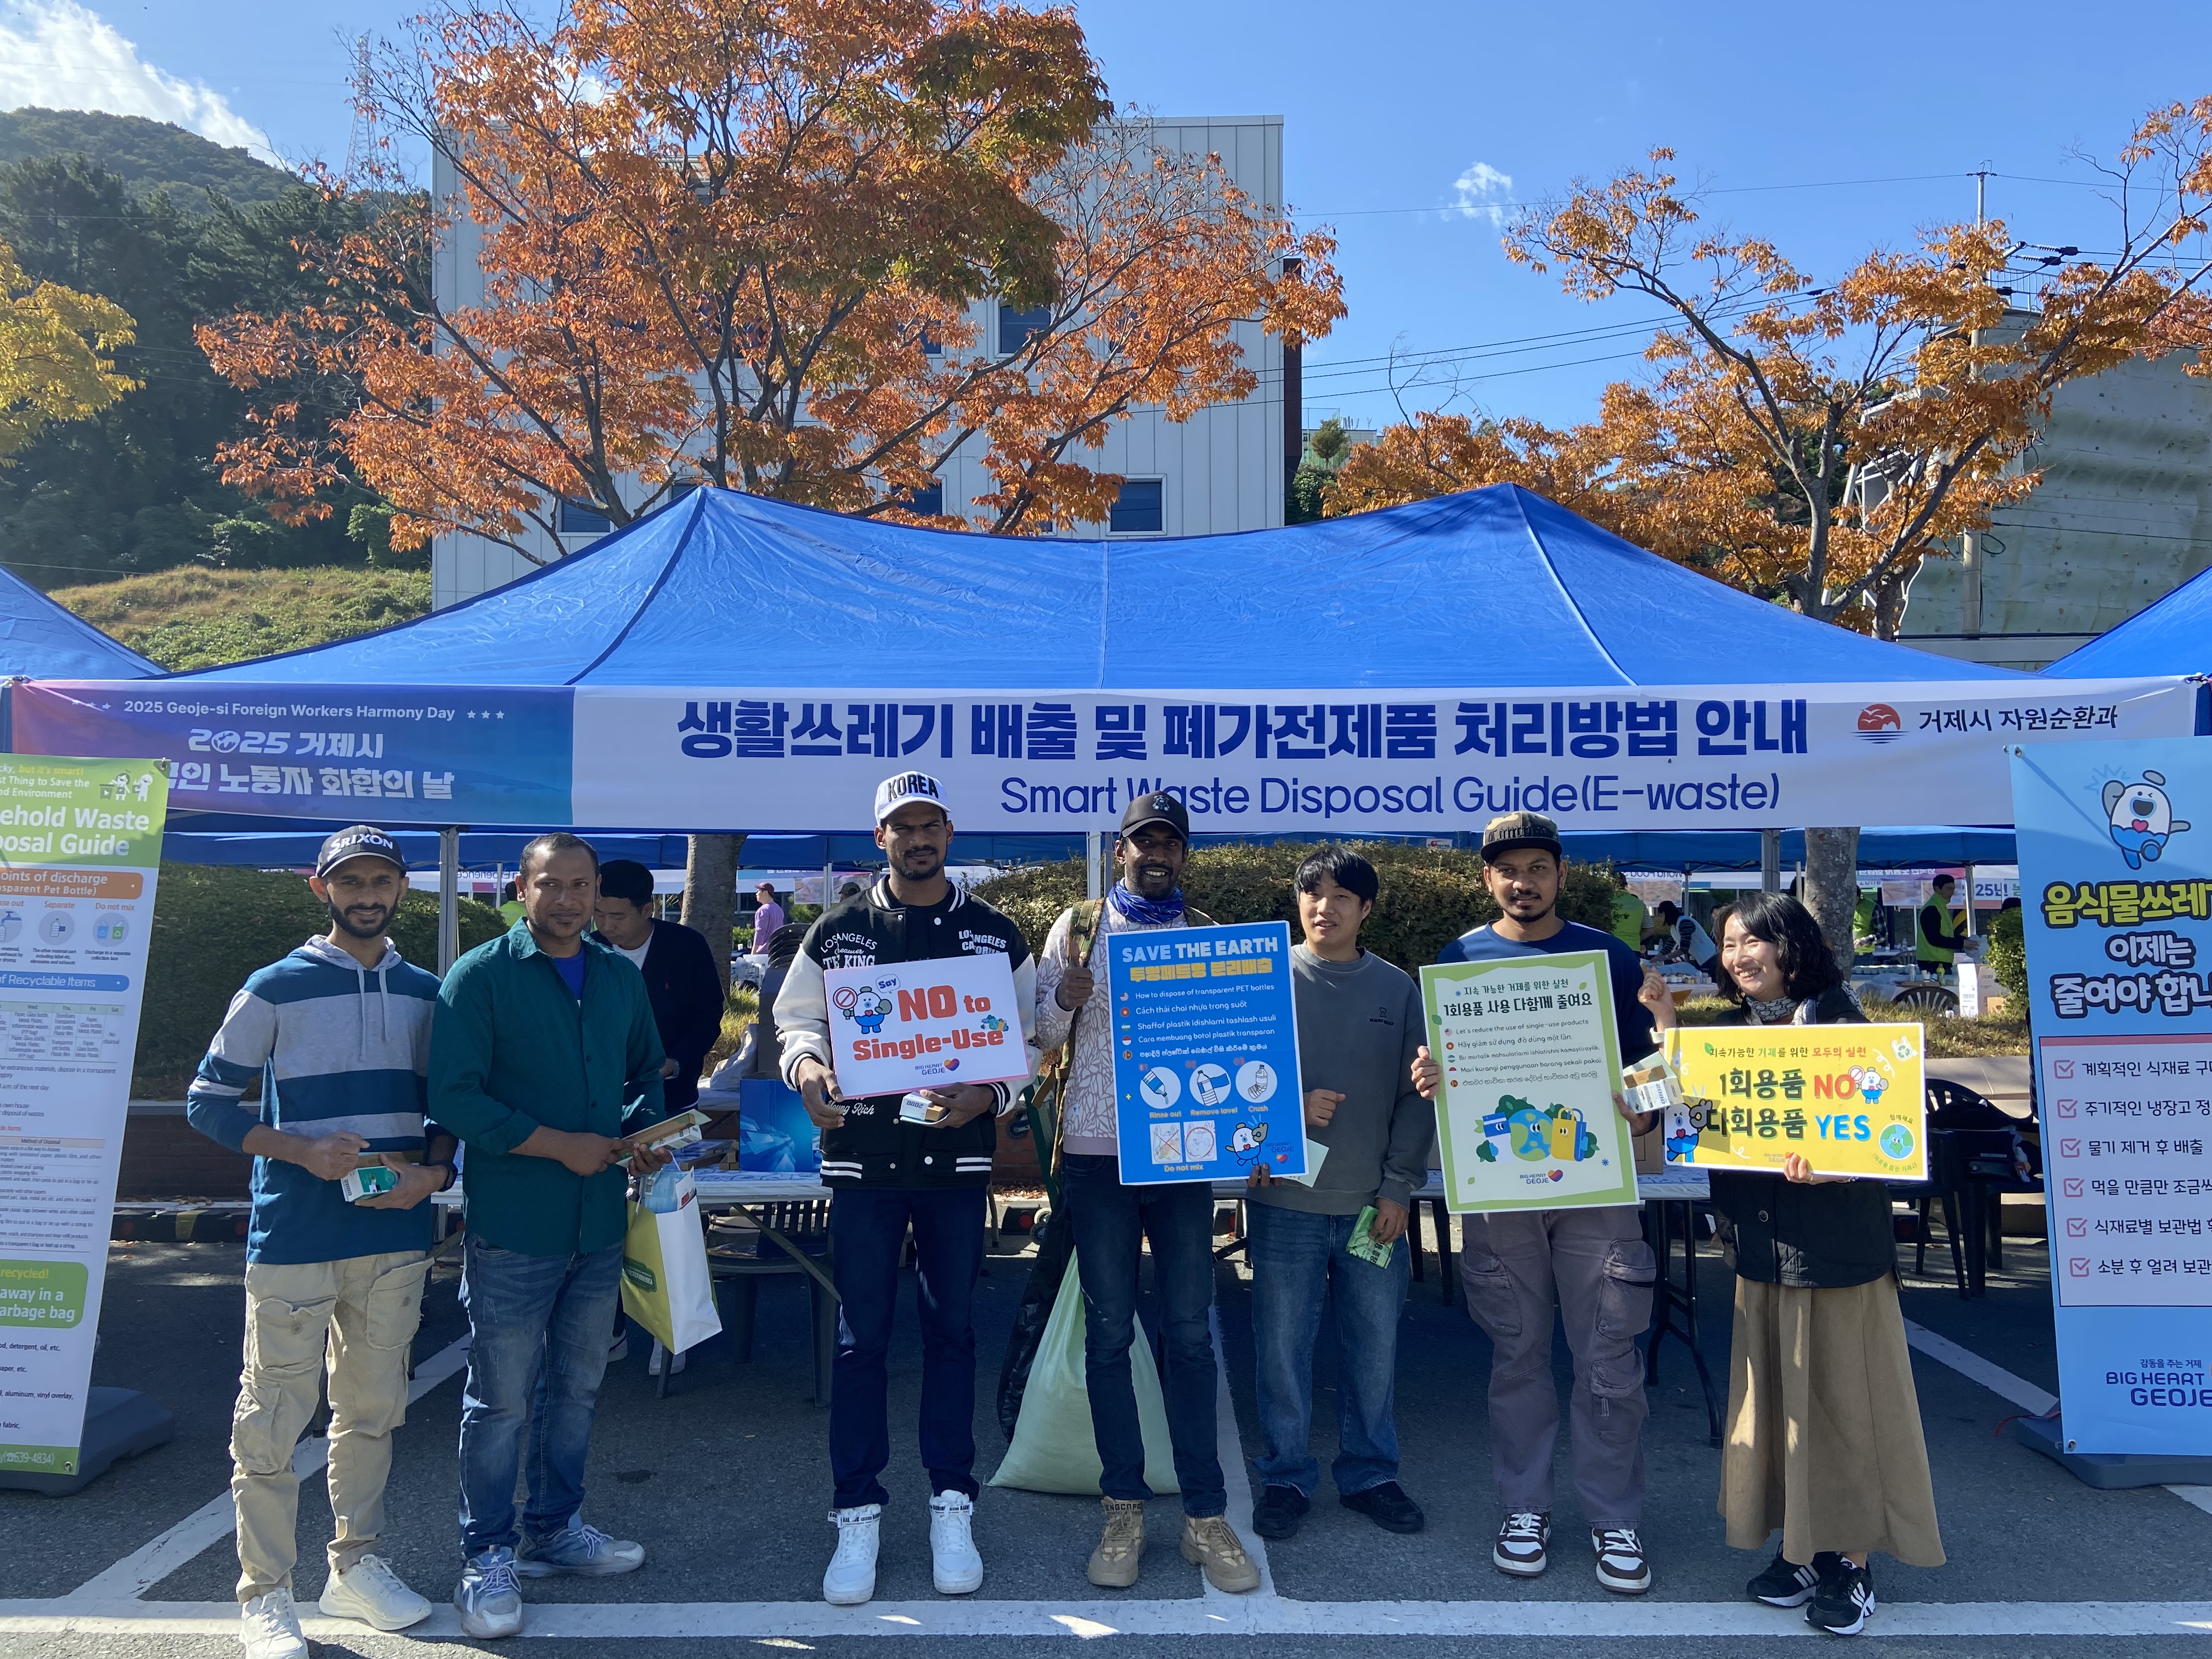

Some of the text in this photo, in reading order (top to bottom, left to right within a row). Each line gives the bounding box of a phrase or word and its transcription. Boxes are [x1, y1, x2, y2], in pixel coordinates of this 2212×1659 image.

[124, 701, 455, 721] 2025 Geoje-si Foreign Workers Harmony Day
[1919, 705, 2118, 733] 거제시 자원순환과
[677, 699, 1808, 760] 생활쓰레기 배출 및 폐가전제품 처리방법 안내
[295, 729, 383, 760] 거제시
[8, 776, 89, 787] Thing to Save the
[218, 761, 314, 798] 노동자
[319, 764, 415, 802] 화합의
[422, 771, 455, 799] 날
[887, 774, 939, 802] KOREA
[12, 788, 72, 799] Environment
[1001, 777, 1117, 814] Smart
[1261, 776, 1444, 816] Disposal
[1453, 772, 1779, 812] Guide(E-waste)
[75, 808, 149, 831] Waste
[60, 833, 129, 855] Guide
[328, 833, 393, 862] SRIXON
[34, 871, 48, 882] of
[50, 872, 108, 885] discharge
[44, 884, 97, 896] Pet Bottle)
[44, 901, 75, 910] Separate
[1122, 936, 1278, 962] SAVE THE EARTH
[2108, 934, 2193, 966] 이제는
[844, 955, 876, 968] KING
[8, 974, 95, 987] Recyclable Items
[878, 978, 897, 989] Say
[1464, 979, 1568, 995] 지속 가능한 거제를 위한 실천
[1195, 986, 1234, 995] transparent
[2053, 976, 2152, 1015] 줄여야
[898, 985, 991, 1022] NO to
[1443, 992, 1592, 1017] 1회용품 사용 다함께 줄여요
[1212, 1030, 1235, 1039] plastik
[853, 1029, 1004, 1060] Single-Use
[1759, 1047, 1786, 1057] 거제를
[1790, 1047, 1809, 1058] 위한
[1812, 1047, 1841, 1057] 모두의
[1846, 1047, 1866, 1057] 실천
[2081, 1061, 2190, 1077] 계획적인 식재료
[1720, 1067, 1806, 1100] 1회용품
[1813, 1074, 1856, 1099] NO
[851, 1103, 875, 1116] Rich
[2085, 1100, 2191, 1116] 주기적인 냉장고
[1706, 1105, 1807, 1140] 다회용품
[1814, 1114, 1872, 1141] YES
[2089, 1139, 2203, 1156] 물기 제거 후 배출
[2092, 1180, 2119, 1195] 먹을
[2125, 1180, 2169, 1195] 만큼만
[2095, 1219, 2201, 1235] 식재료별 보관법
[1, 1268, 49, 1280] recycled!
[2098, 1259, 2124, 1274] 소분
[2129, 1259, 2142, 1274] 후
[2147, 1259, 2177, 1275] 얼려
[0, 1287, 64, 1303] away in a
[49, 1305, 75, 1322] bag
[2140, 1359, 2202, 1368] 감동을 주는 거제
[2106, 1372, 2205, 1385] BIG HEART
[2131, 1388, 2212, 1407] GEOJE
